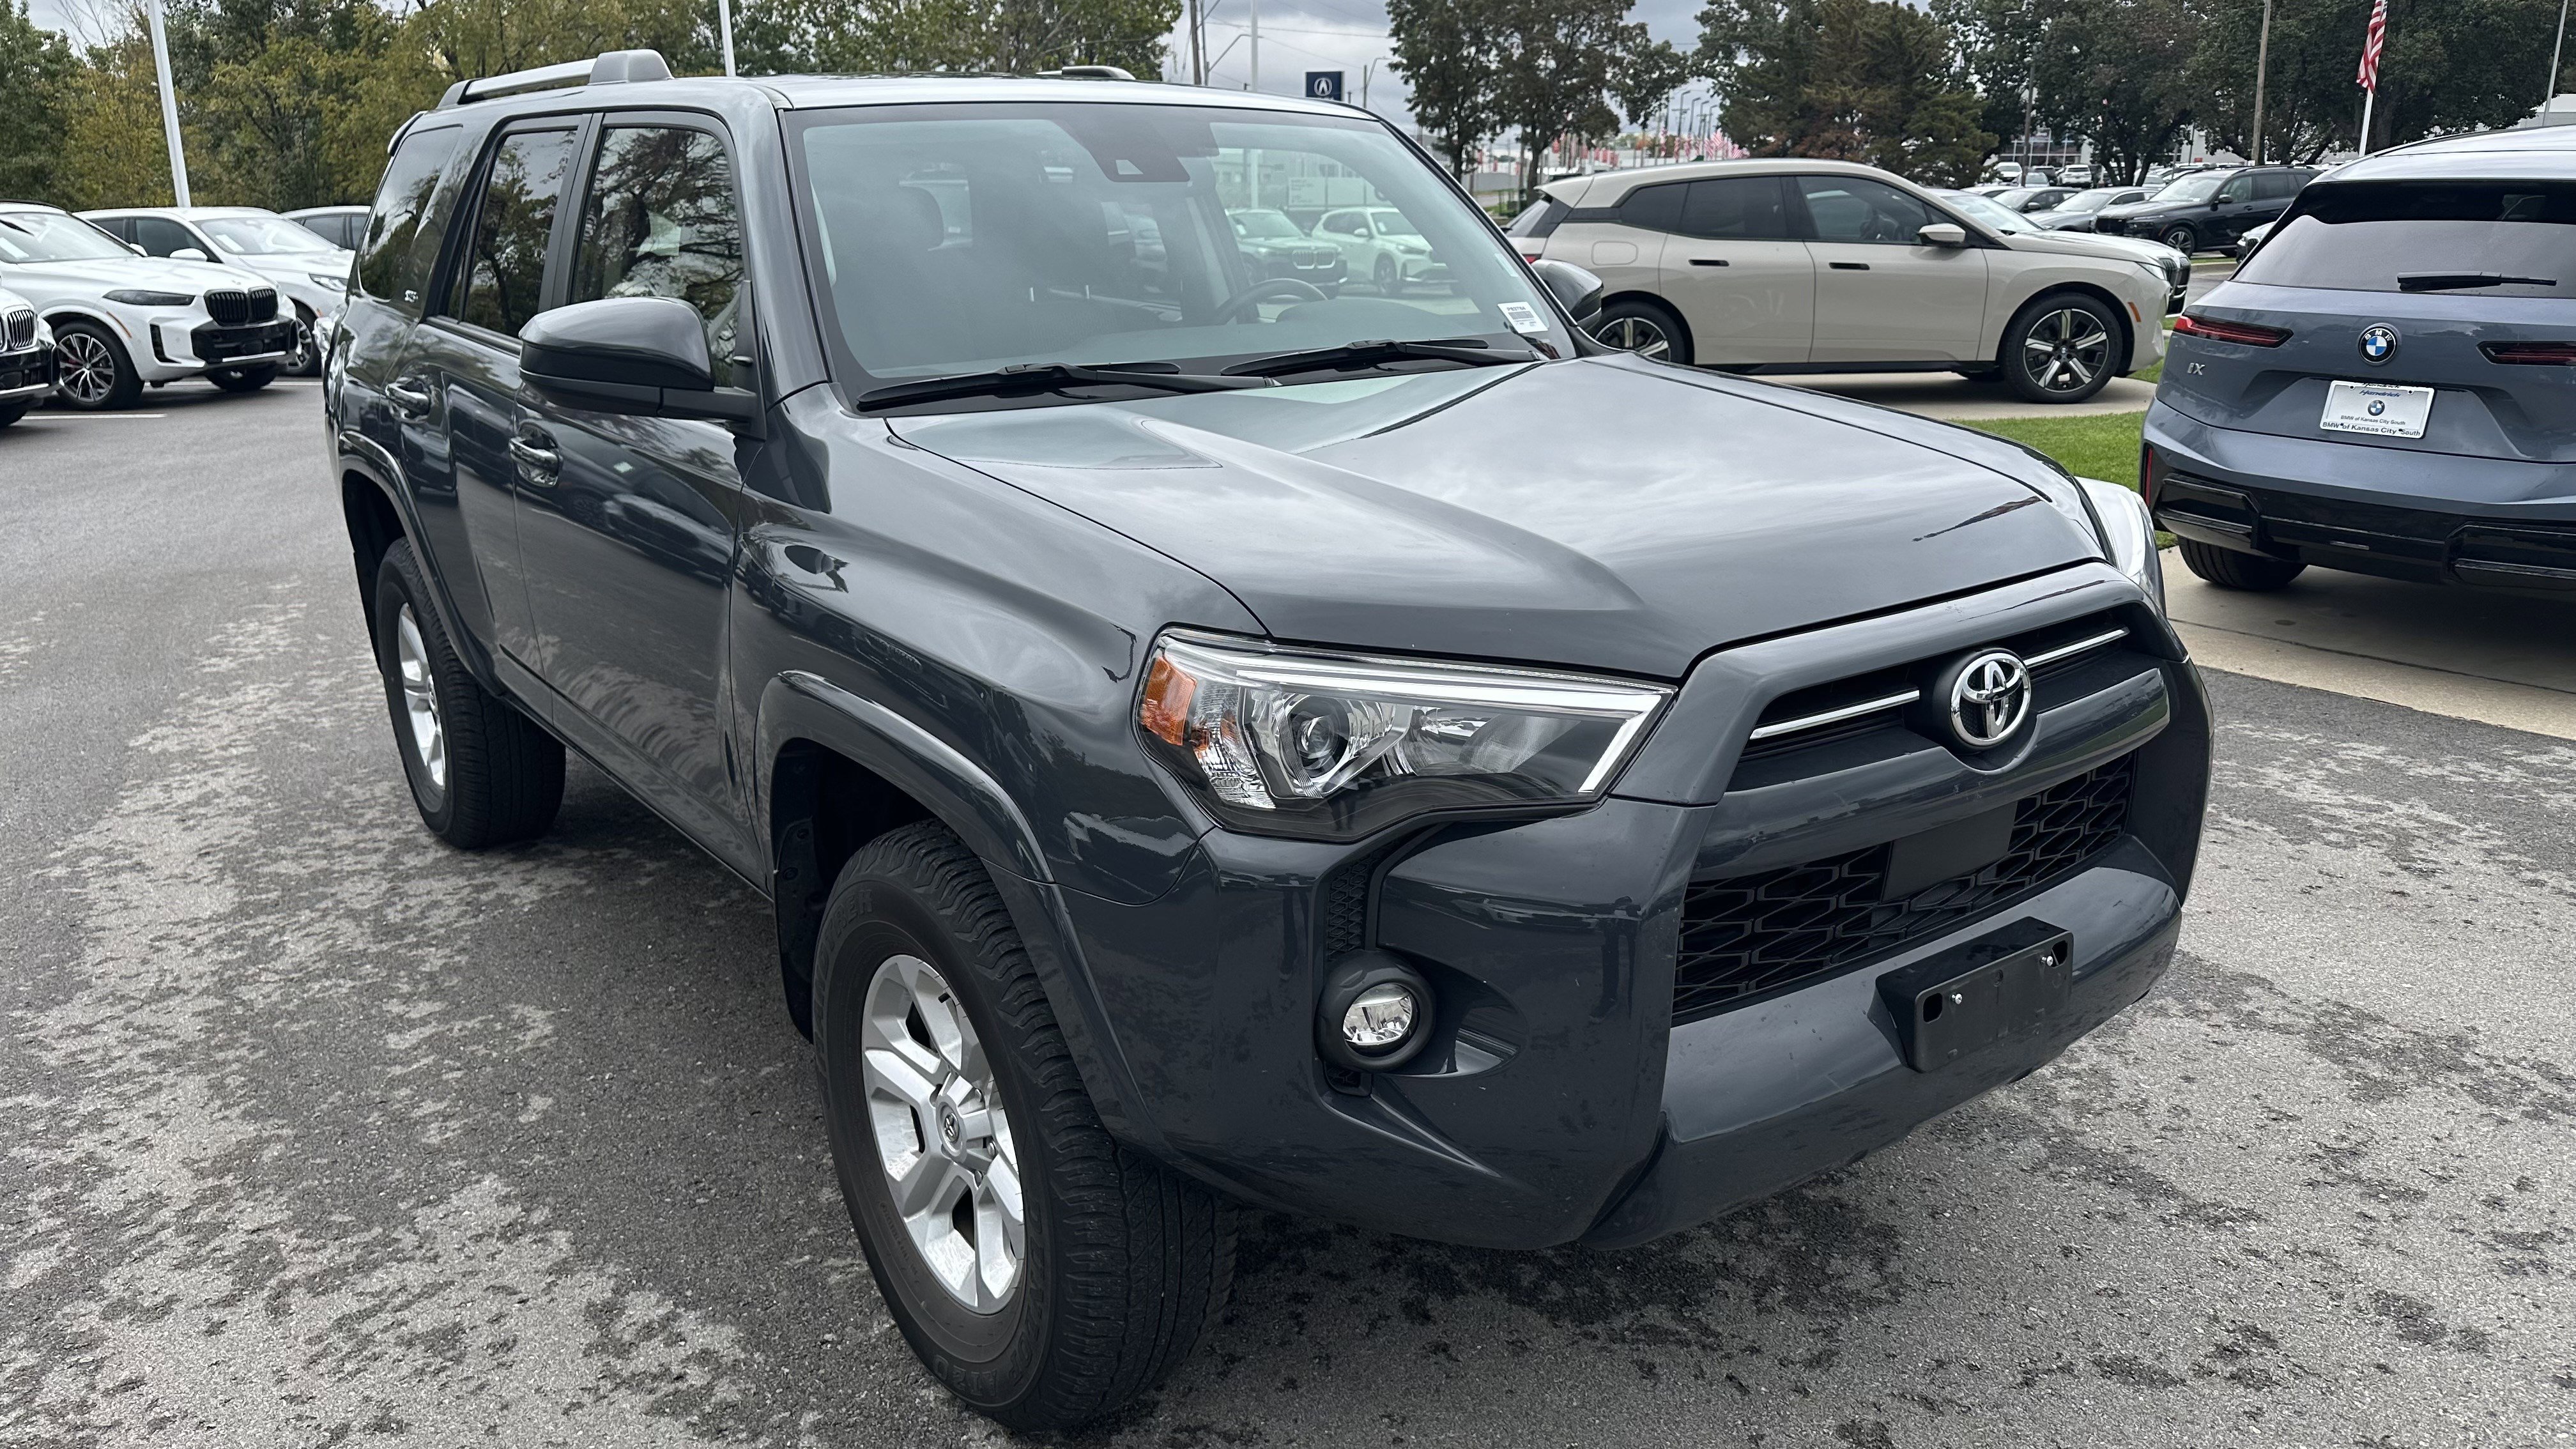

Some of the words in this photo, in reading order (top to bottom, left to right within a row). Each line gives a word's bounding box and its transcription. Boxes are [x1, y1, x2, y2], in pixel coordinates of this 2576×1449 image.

[2365, 330, 2393, 342] BMW
[2351, 424, 2379, 433] Kansas
[2380, 427, 2397, 435] City
